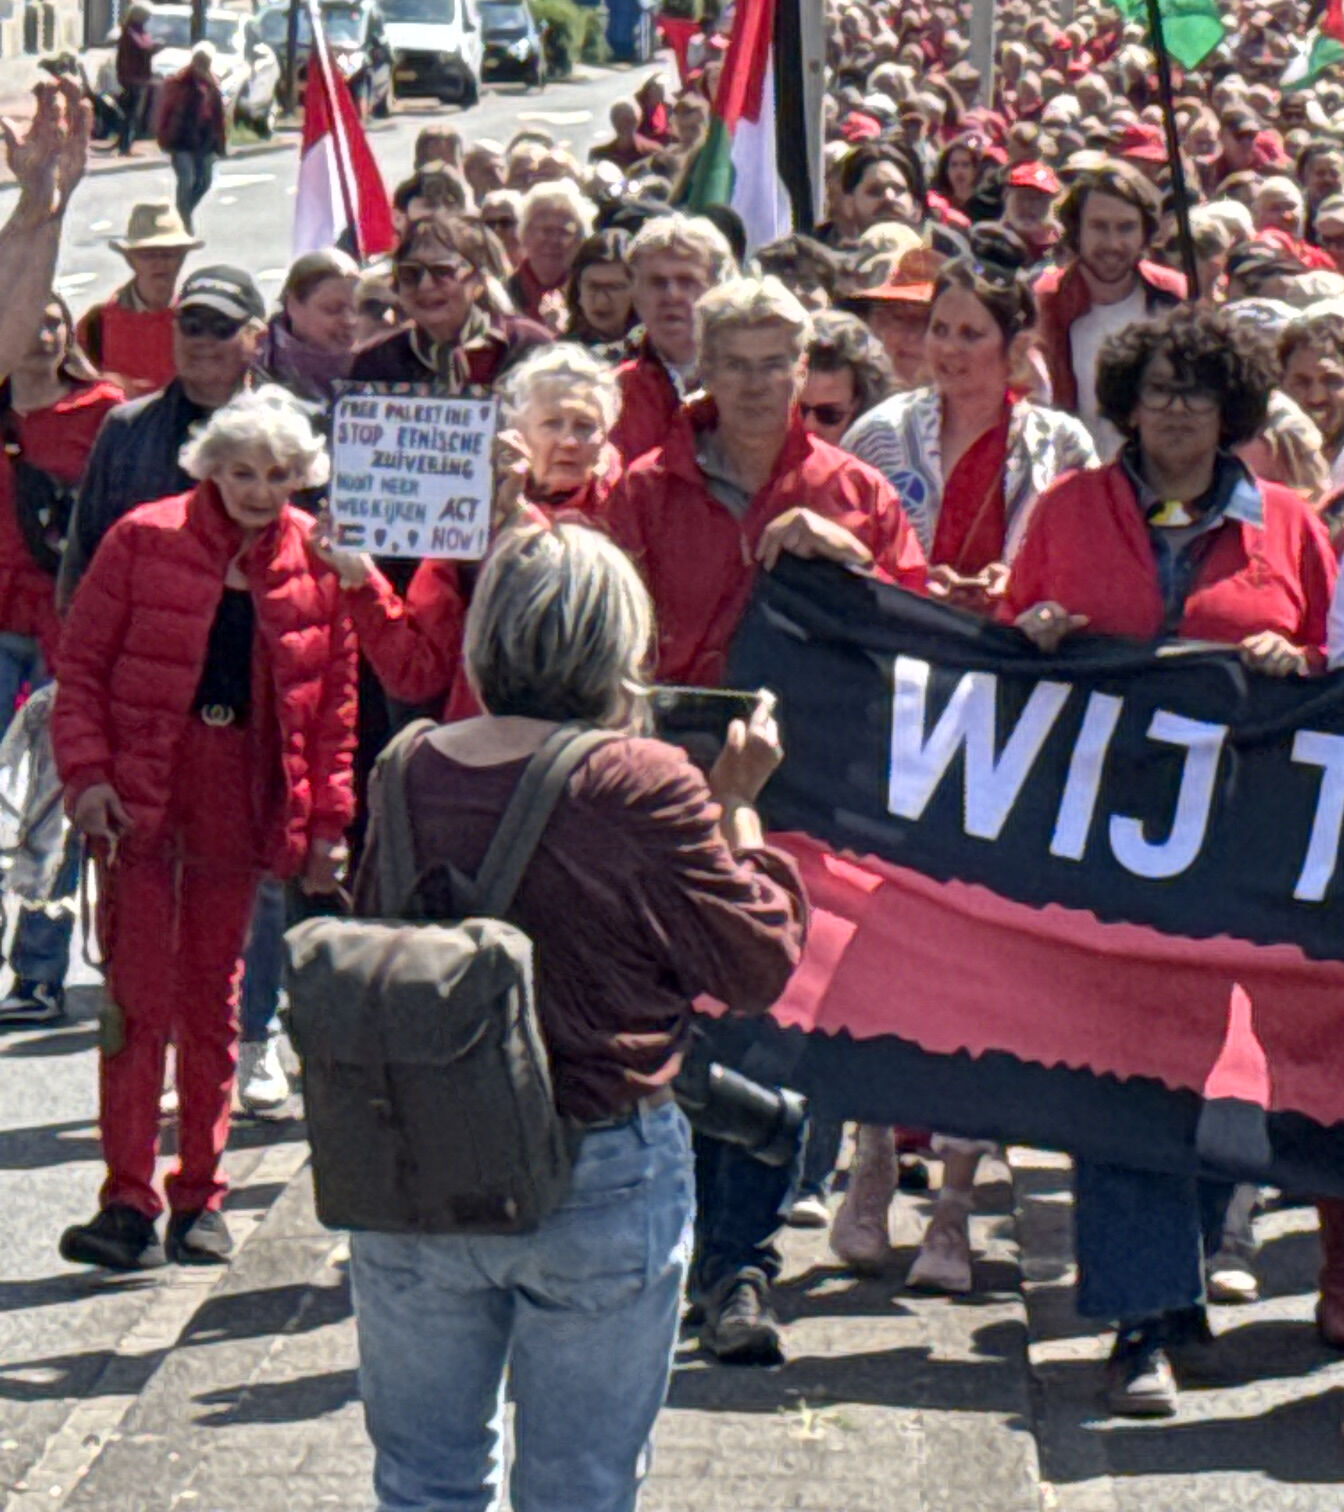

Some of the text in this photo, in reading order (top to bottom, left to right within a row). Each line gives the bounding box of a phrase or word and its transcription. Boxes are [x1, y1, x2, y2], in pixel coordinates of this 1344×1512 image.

[340, 401, 379, 419] FREE
[338, 422, 485, 455] STOP ETNISCHE
[371, 449, 475, 480] ZUIVERING
[438, 496, 481, 523] ACT
[887, 653, 1229, 879] WIJ
